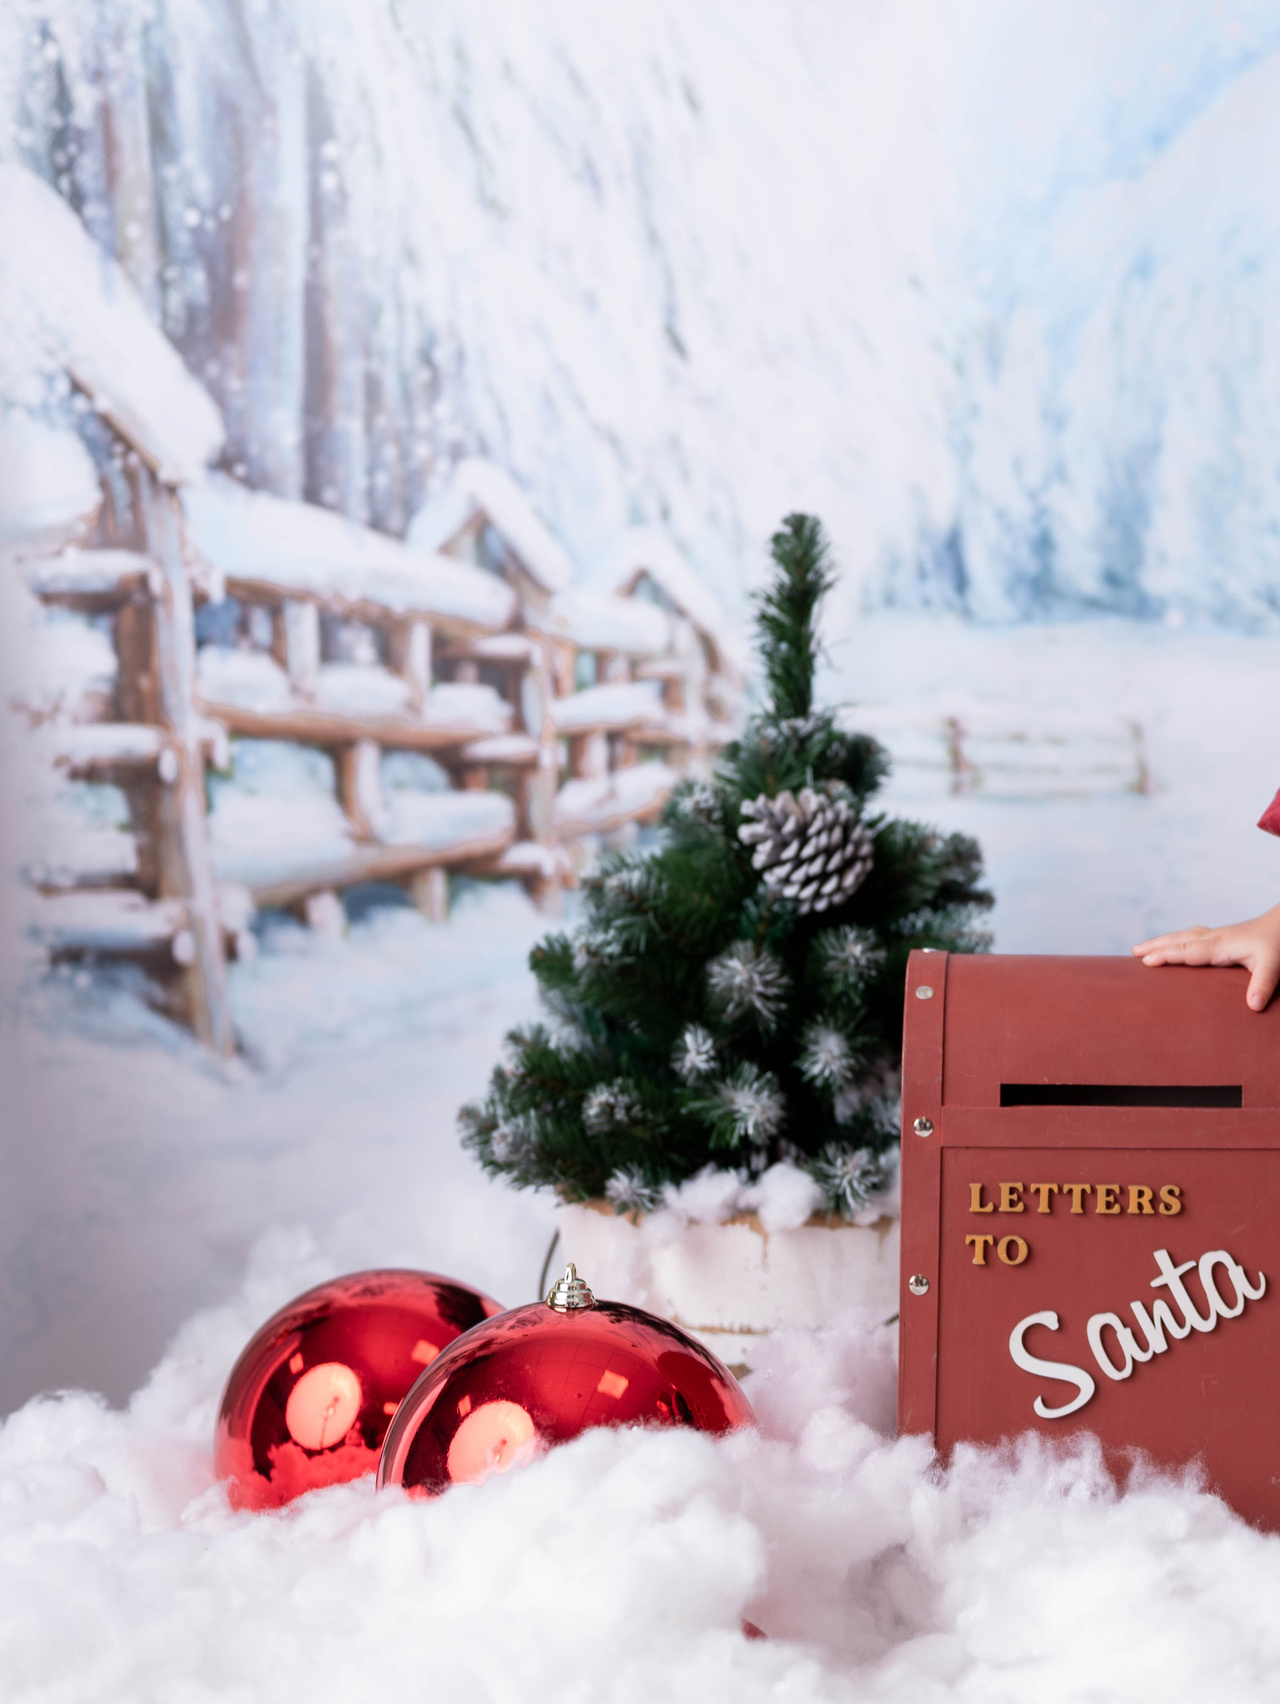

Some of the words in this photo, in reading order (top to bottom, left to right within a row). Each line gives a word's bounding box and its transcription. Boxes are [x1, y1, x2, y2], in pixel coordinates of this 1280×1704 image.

[968, 1182, 1183, 1216] LETTERS
[965, 1233, 1029, 1267] TO
[1008, 1248, 1267, 1420] Santa
